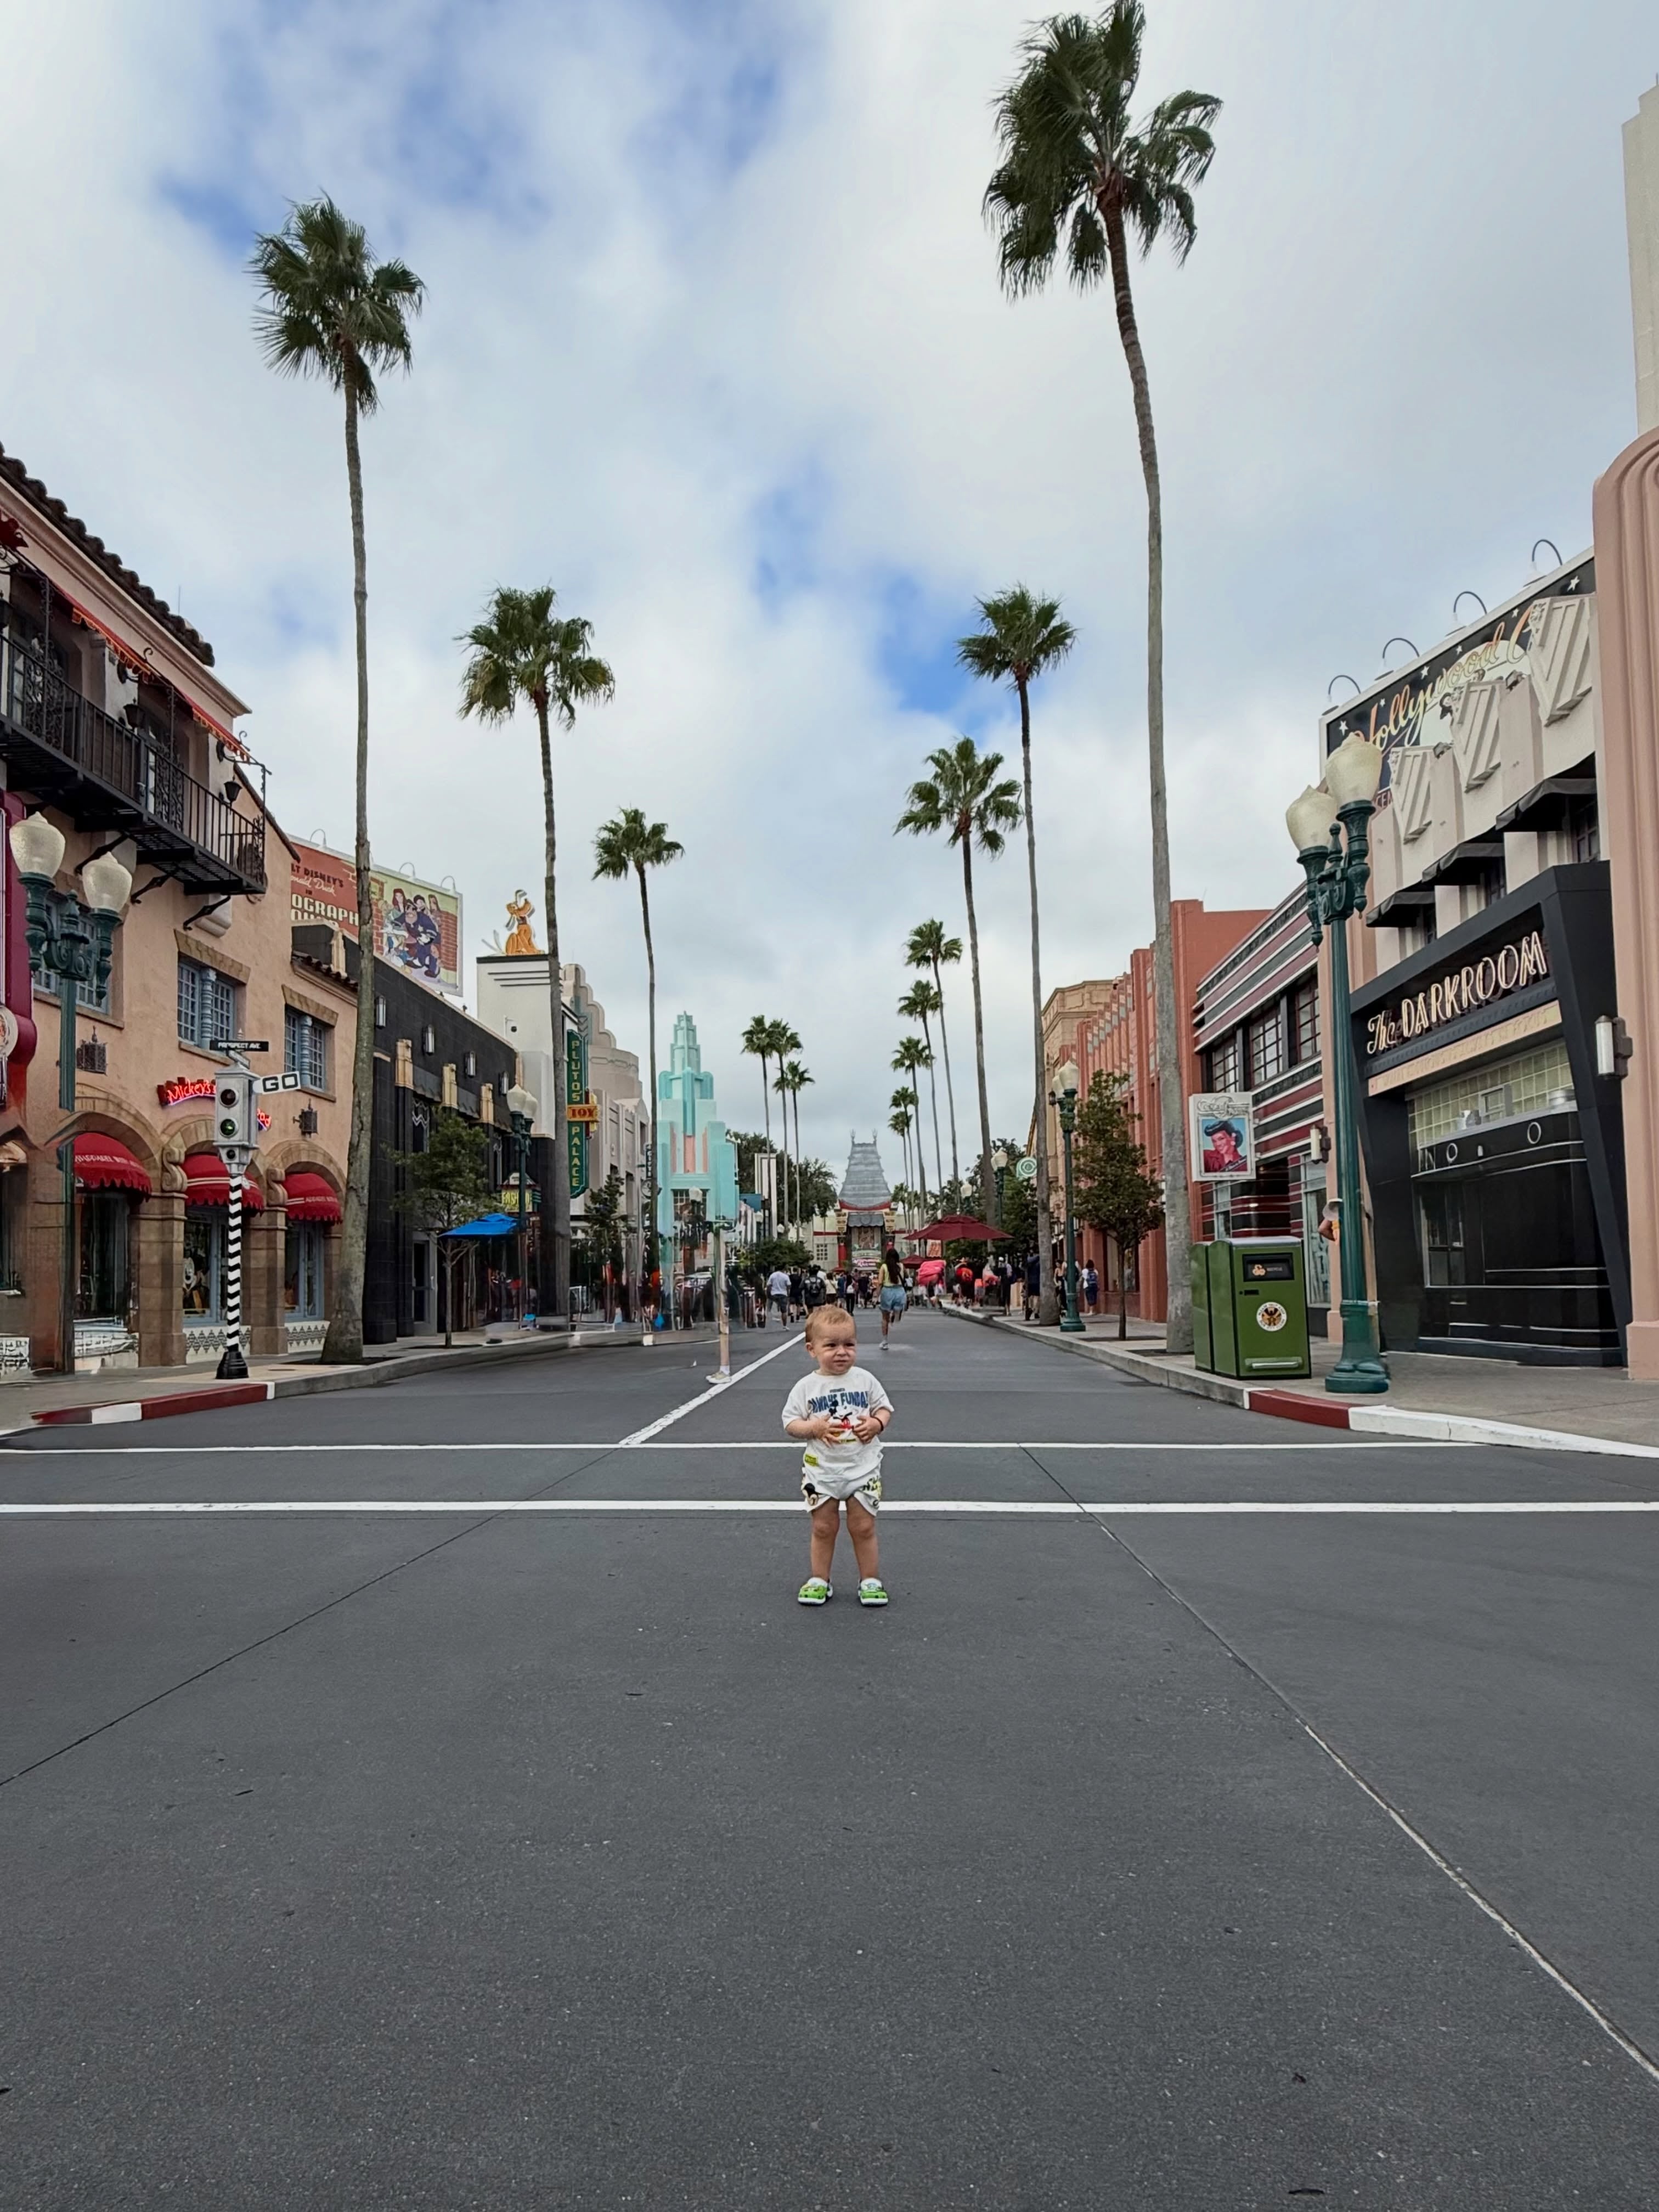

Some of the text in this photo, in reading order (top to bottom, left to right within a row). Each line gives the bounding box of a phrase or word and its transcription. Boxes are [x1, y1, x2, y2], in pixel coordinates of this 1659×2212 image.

[291, 863, 301, 873] LT
[290, 875, 312, 888] onald
[291, 893, 359, 926] OGRAPH
[1367, 1009, 1397, 1054] The
[1401, 931, 1547, 1037] DARKROOM
[167, 1079, 212, 1104] Mickey's
[262, 1073, 298, 1092] GO
[571, 1126, 581, 1187] PALACE
